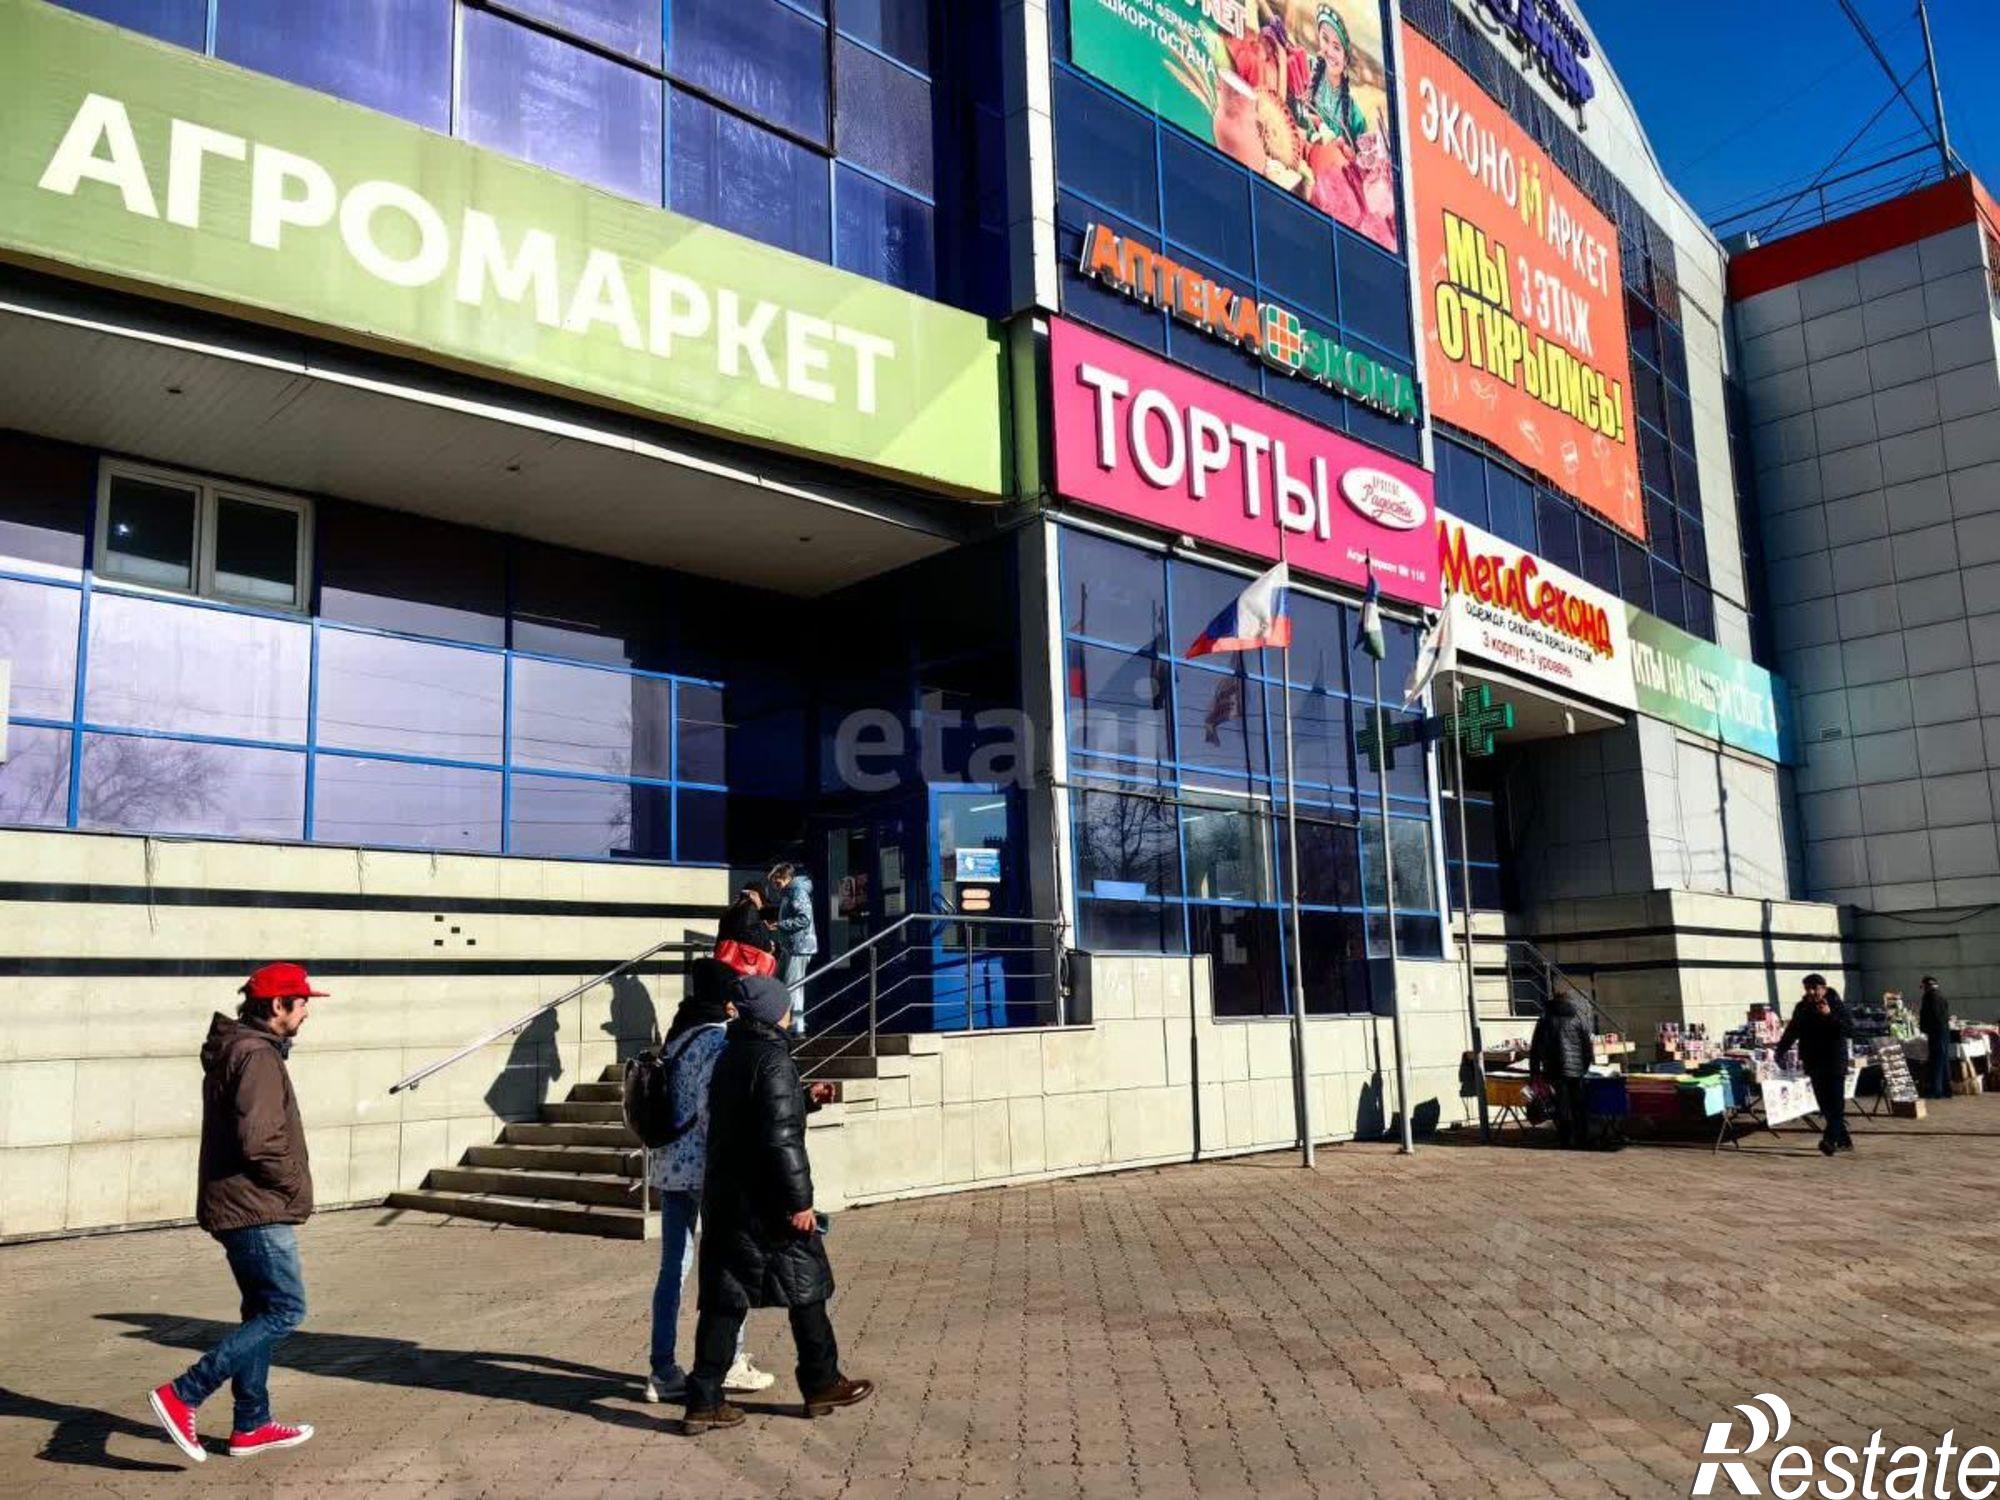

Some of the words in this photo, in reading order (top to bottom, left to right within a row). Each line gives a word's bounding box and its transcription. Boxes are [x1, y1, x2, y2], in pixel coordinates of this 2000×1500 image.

[37, 92, 896, 415] АГРОМАРКЕТ
[1080, 223, 1266, 355] АПТЕКА
[1442, 207, 1512, 315] МЫ
[1534, 268, 1594, 360] ЭТАЖ
[1434, 280, 1625, 446] ОТКРЫЛИСЬ!
[1077, 362, 1332, 541] ТОРТЫ
